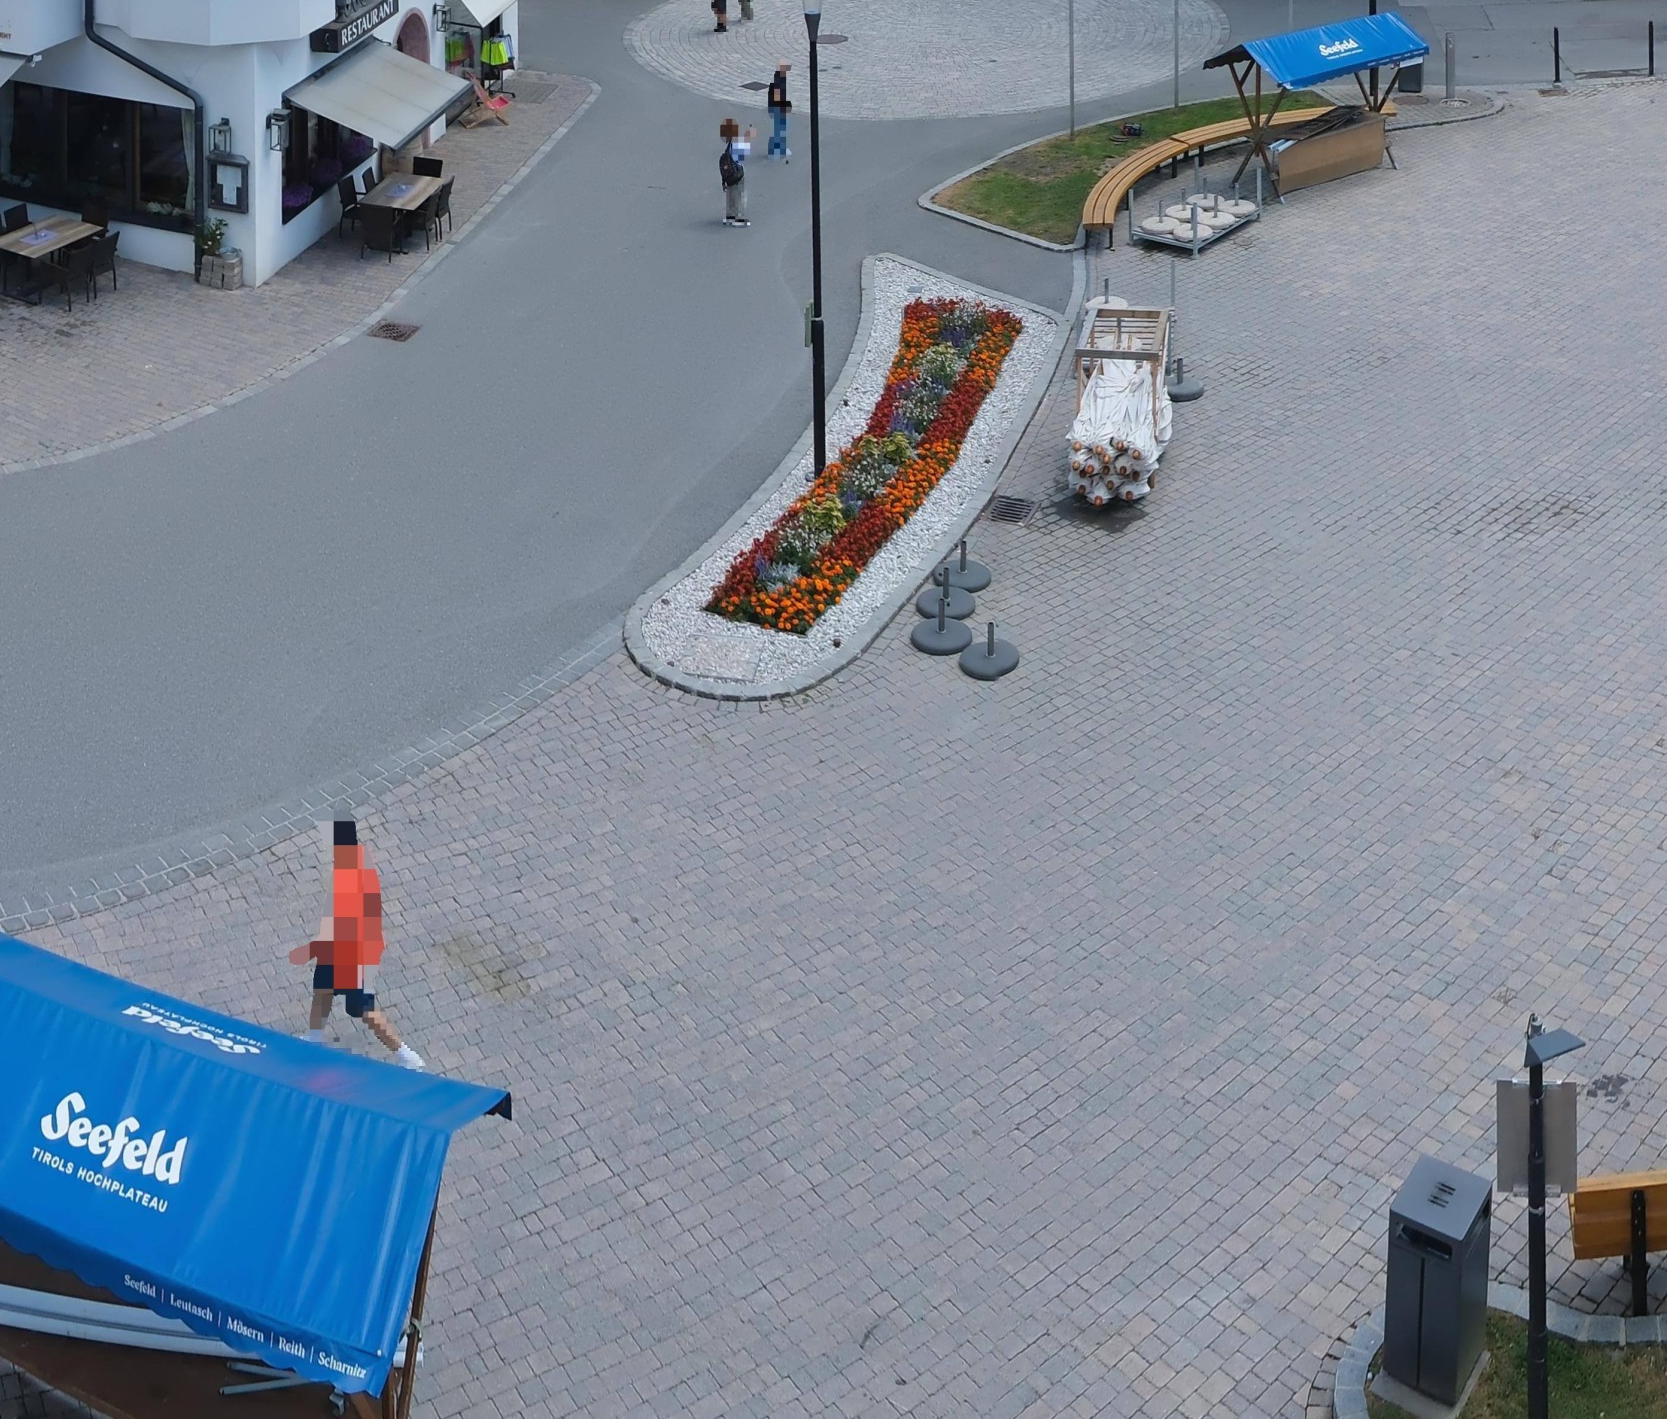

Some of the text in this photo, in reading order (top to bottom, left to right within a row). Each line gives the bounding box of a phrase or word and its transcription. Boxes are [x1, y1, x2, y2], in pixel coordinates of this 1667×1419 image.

[1319, 37, 1360, 57] Seefeld
[121, 1004, 262, 1056] Seefeld
[40, 1091, 188, 1186] Seefeld
[31, 1146, 169, 1213] TIROLS HOCHPLATEAU
[124, 1274, 367, 1380] Seefeld Leutasch Mösern Reith Scharnitz
